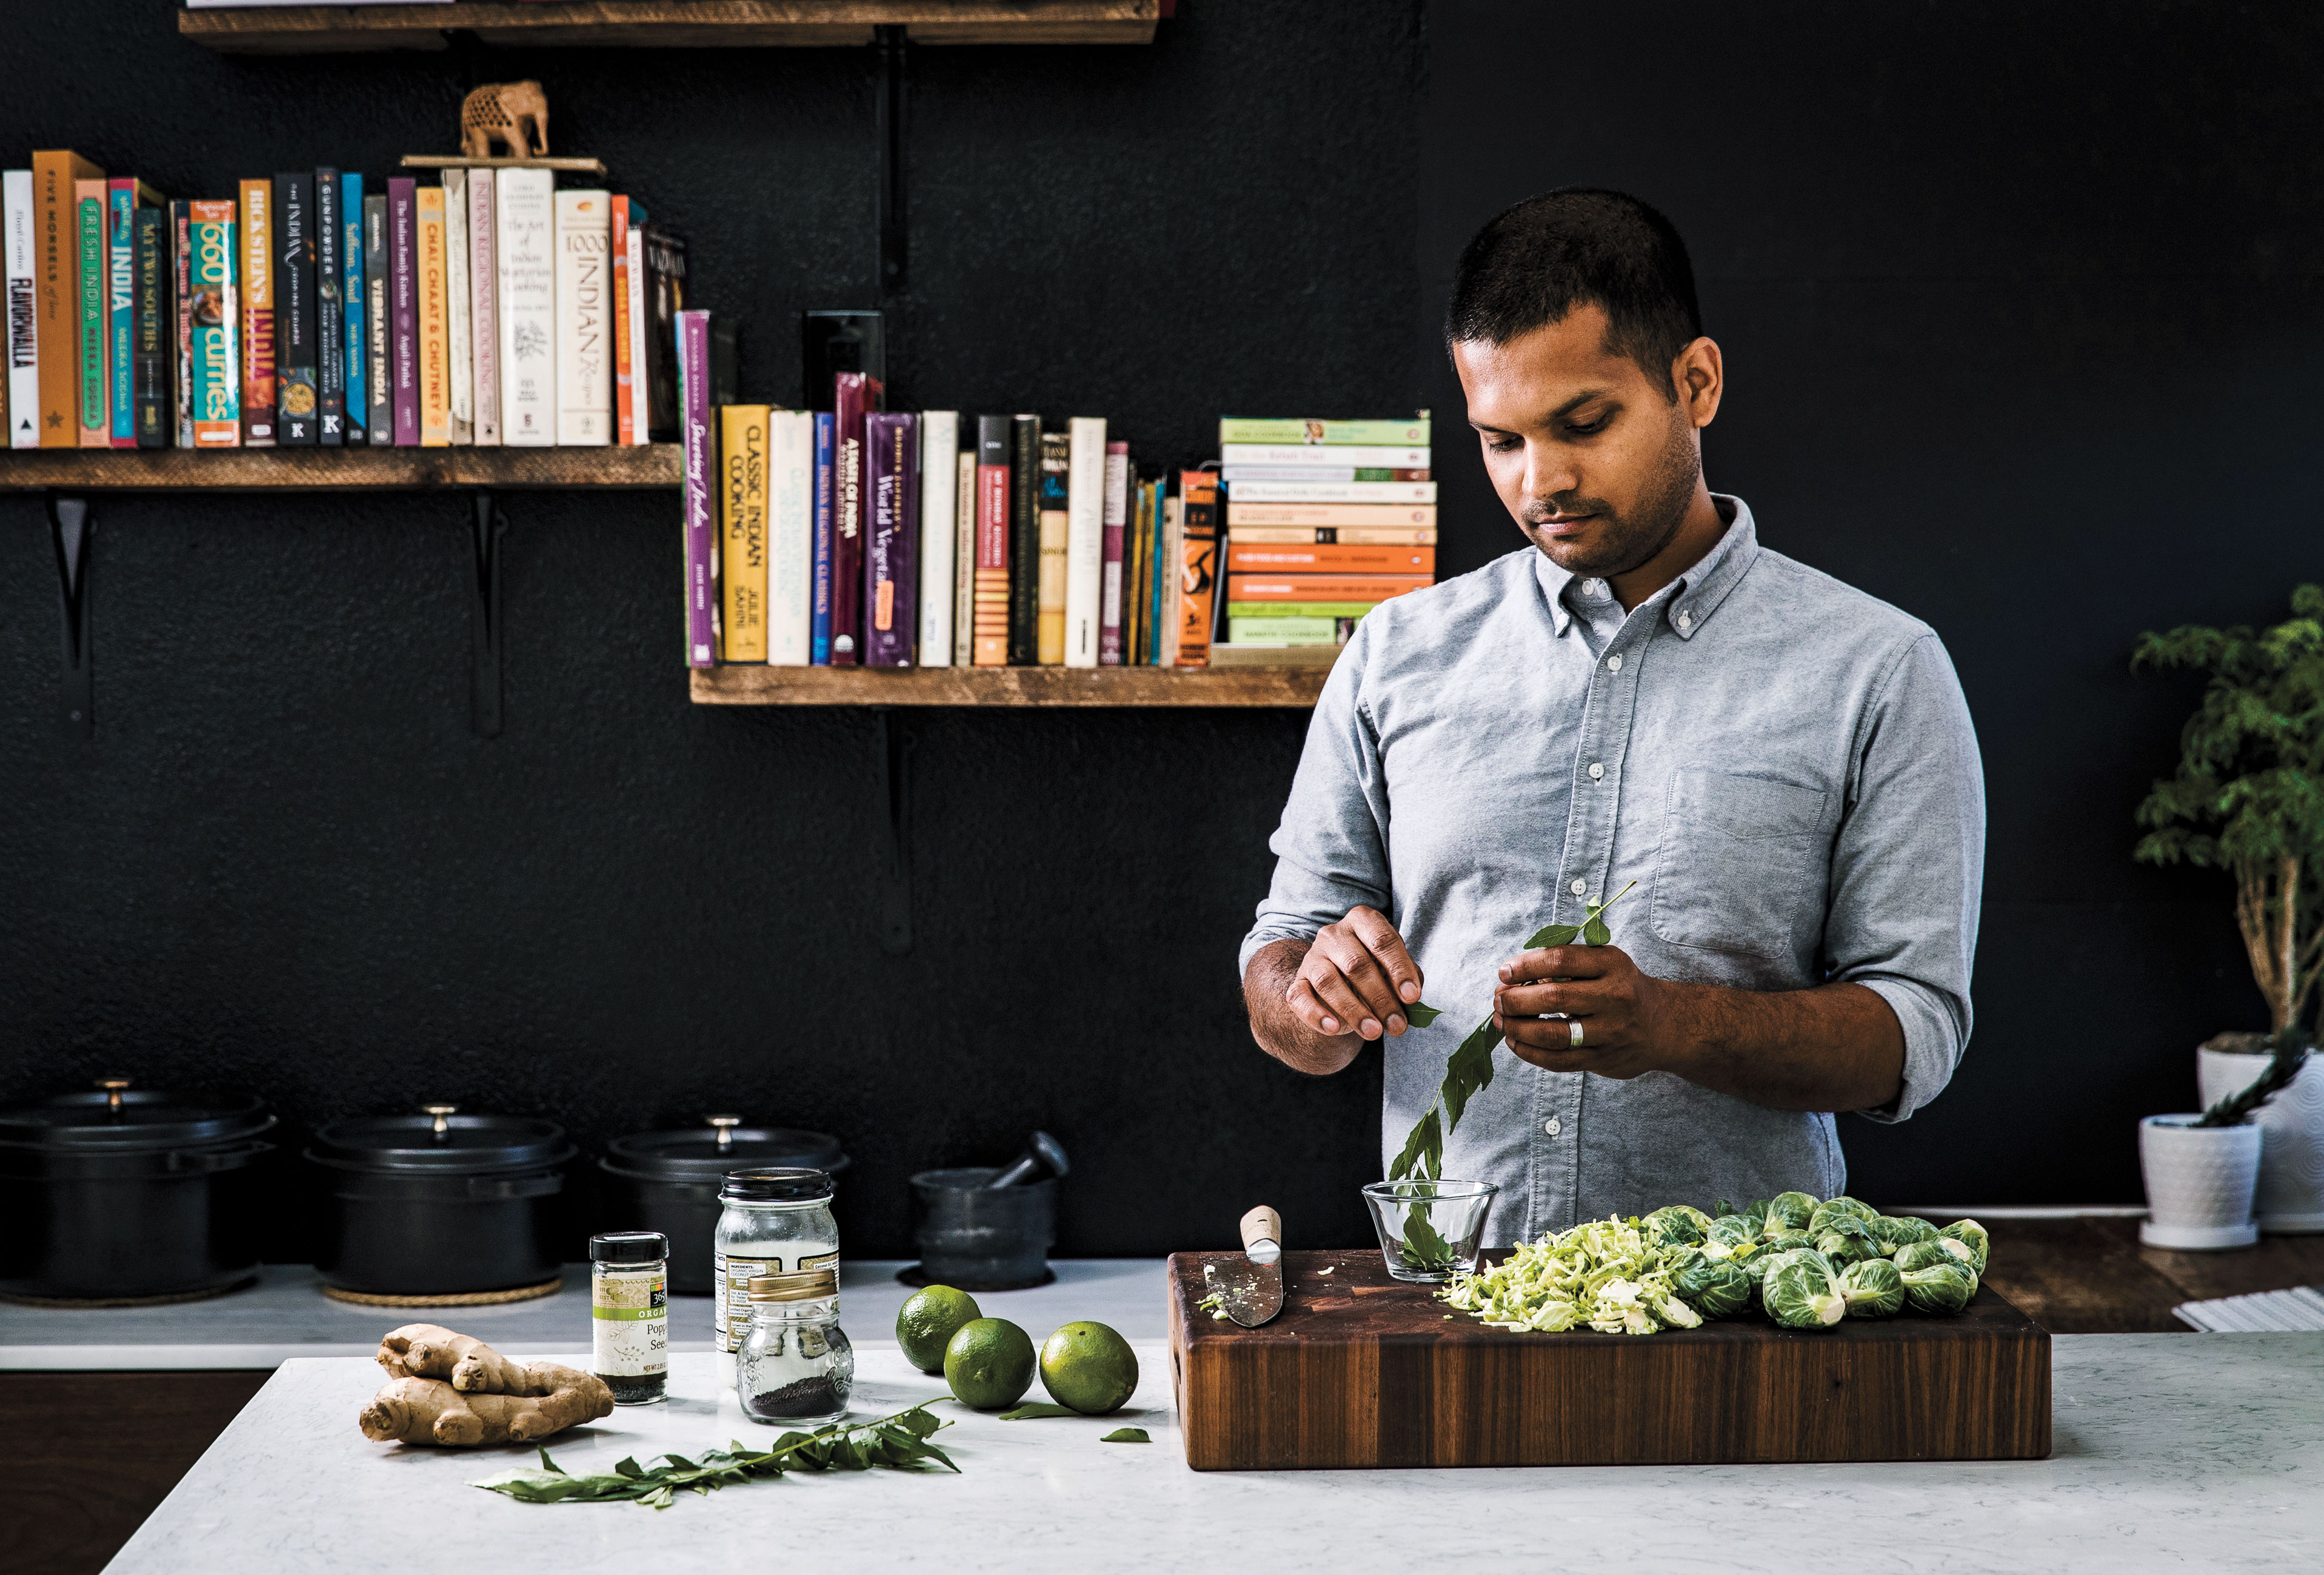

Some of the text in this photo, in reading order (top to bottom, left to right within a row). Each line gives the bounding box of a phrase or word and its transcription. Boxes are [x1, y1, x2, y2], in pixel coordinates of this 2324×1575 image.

[47, 170, 56, 204] FIVE
[47, 210, 59, 283] MORSELS
[84, 206, 101, 321] FRESH INDIA
[142, 224, 155, 244] MY
[200, 223, 228, 284] 660
[249, 190, 267, 304] RICK STEIN'S
[321, 184, 333, 275] GUNPOWDER
[112, 246, 133, 312] INDIA
[143, 250, 156, 286] TWO
[144, 287, 158, 352] SOUTHS
[578, 256, 599, 354] INDIAN
[245, 308, 275, 382] INDIA
[371, 278, 386, 406] VIBRANT INDIA
[427, 338, 441, 411] CHUTNEY
[291, 423, 304, 438] K
[323, 415, 340, 433] K
[729, 455, 746, 539] COOKING
[746, 425, 763, 567] CLASSIC INDIAN
[877, 475, 895, 525] World
[653, 1291, 666, 1304] 365
